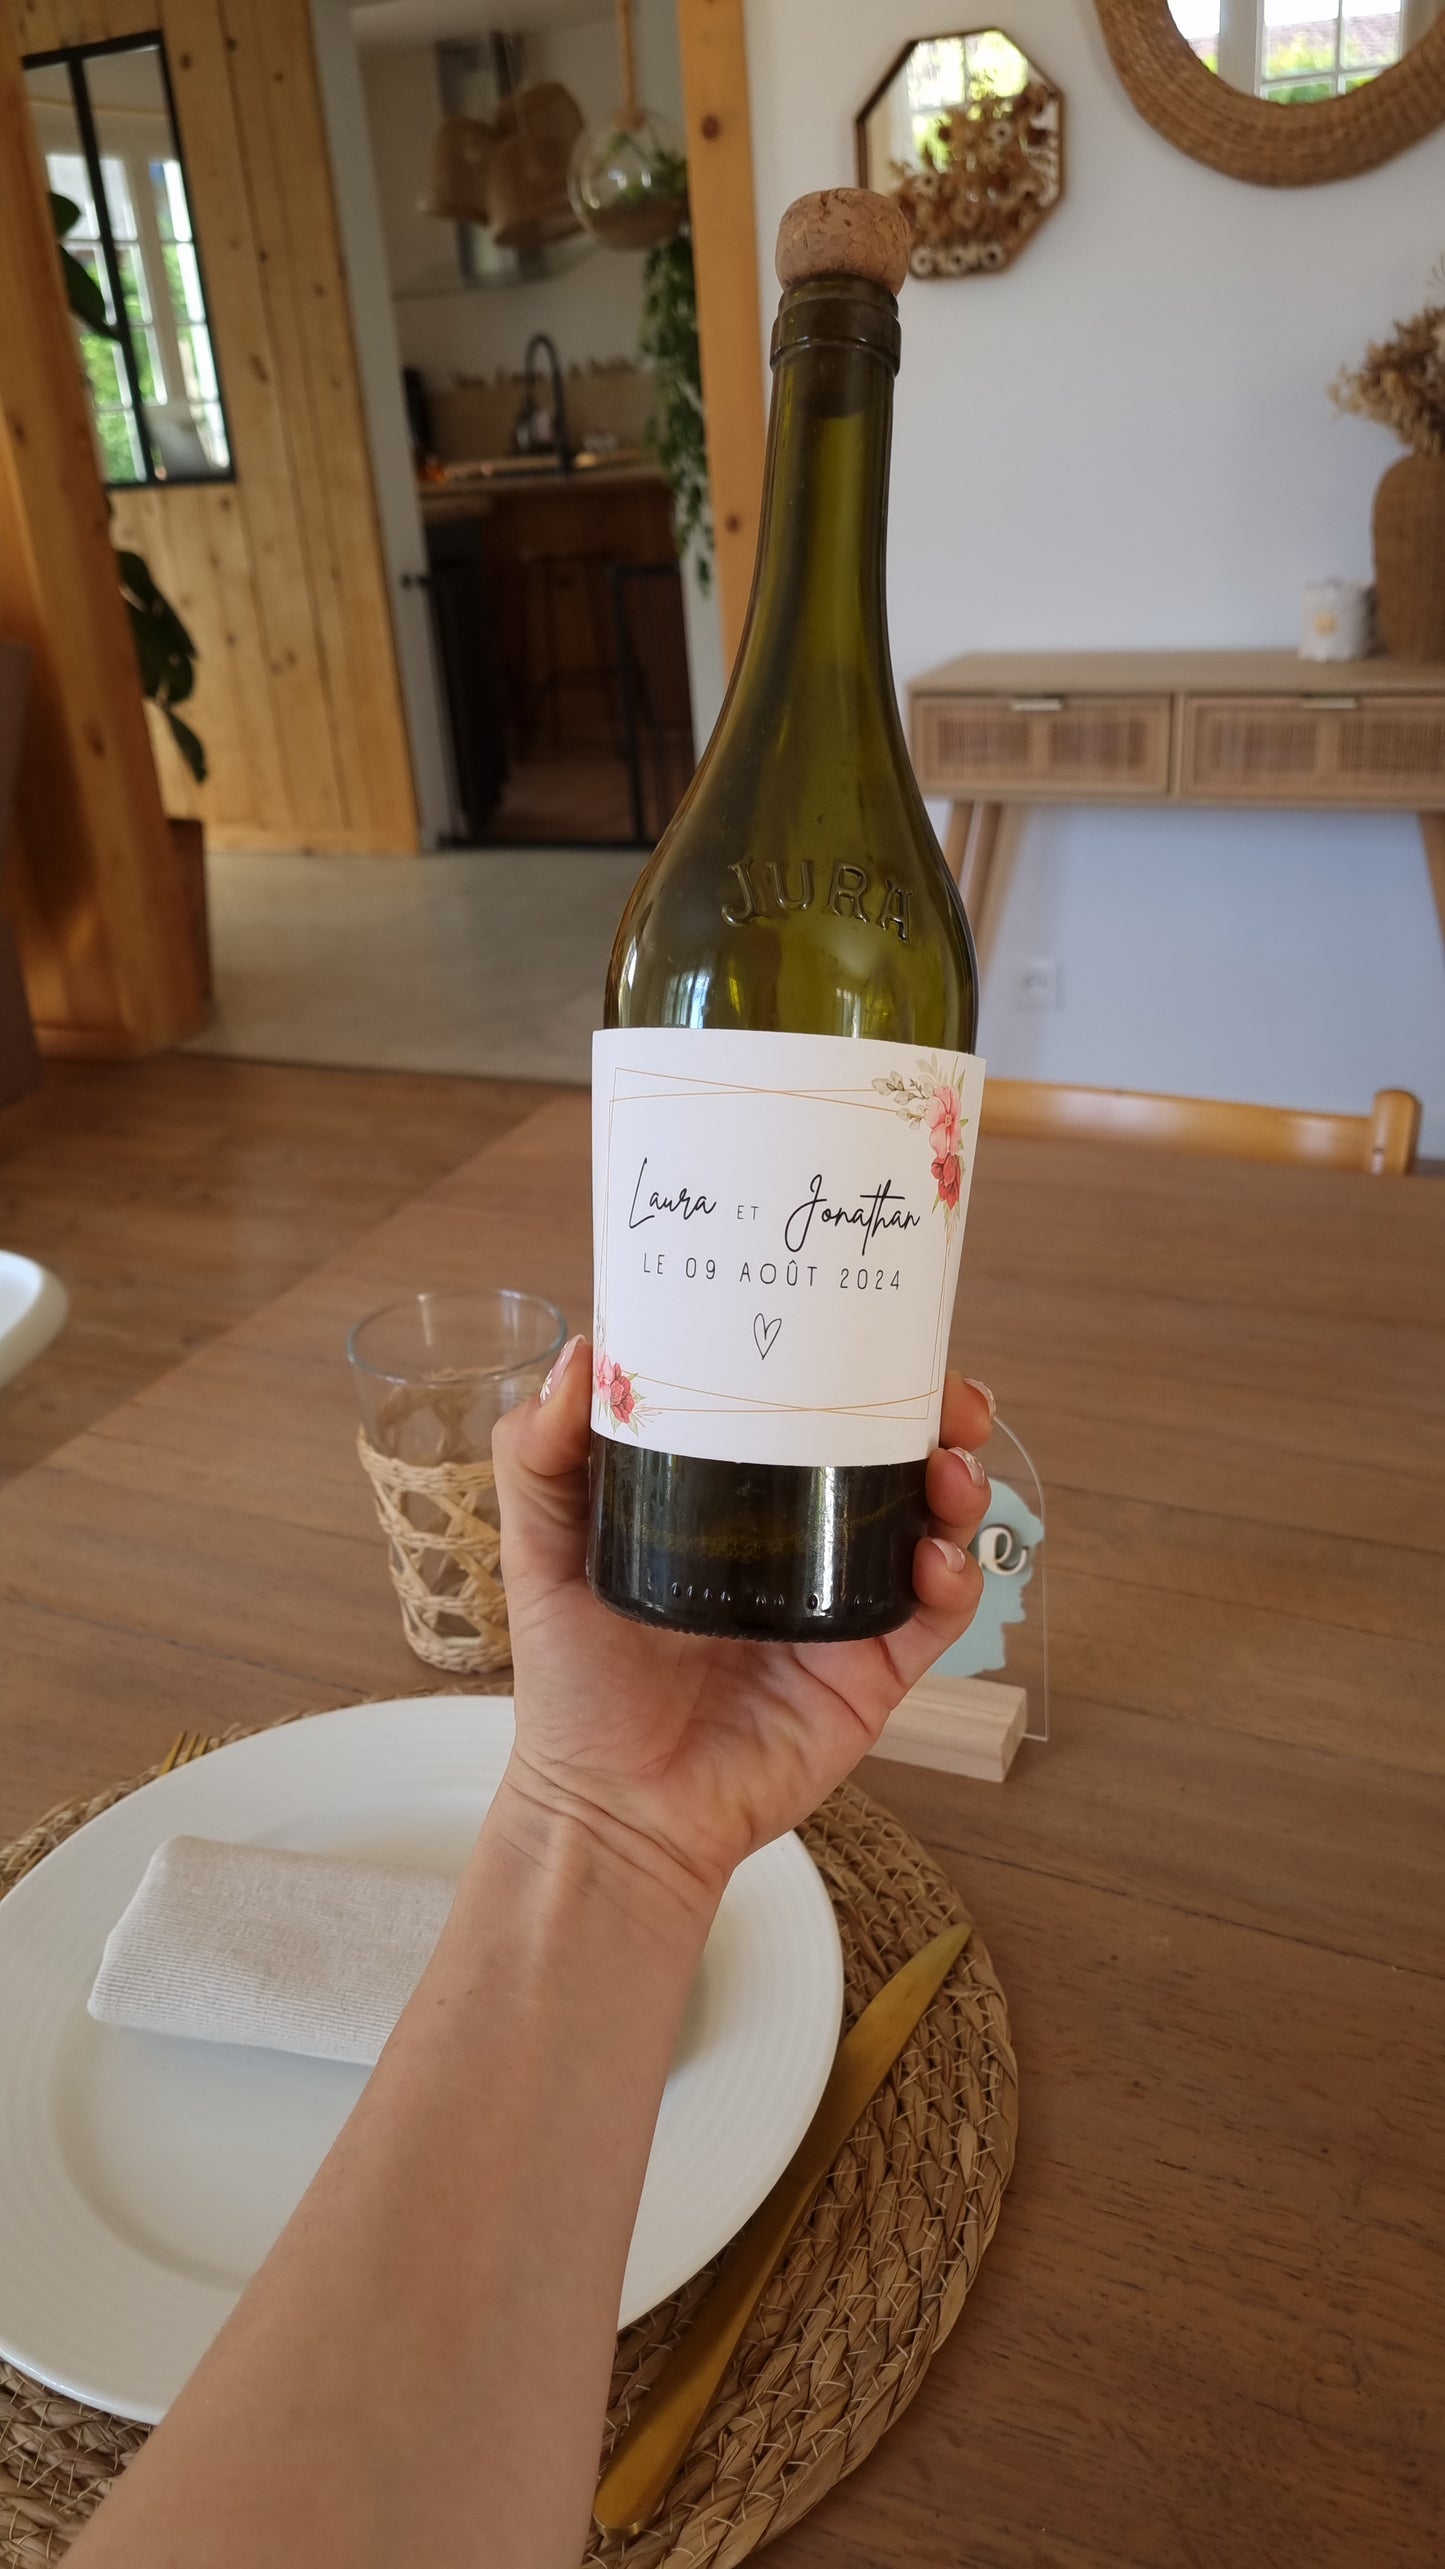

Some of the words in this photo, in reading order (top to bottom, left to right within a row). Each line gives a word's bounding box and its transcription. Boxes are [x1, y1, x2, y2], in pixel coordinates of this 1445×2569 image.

[721, 858, 915, 943] JURA
[628, 1156, 718, 1230] Laura
[736, 1204, 760, 1221] ET
[784, 1173, 921, 1257] Jonathan
[643, 1252, 666, 1275] LE
[685, 1256, 717, 1281] 09
[739, 1259, 818, 1288] AOÛT
[839, 1267, 901, 1291] 2024
